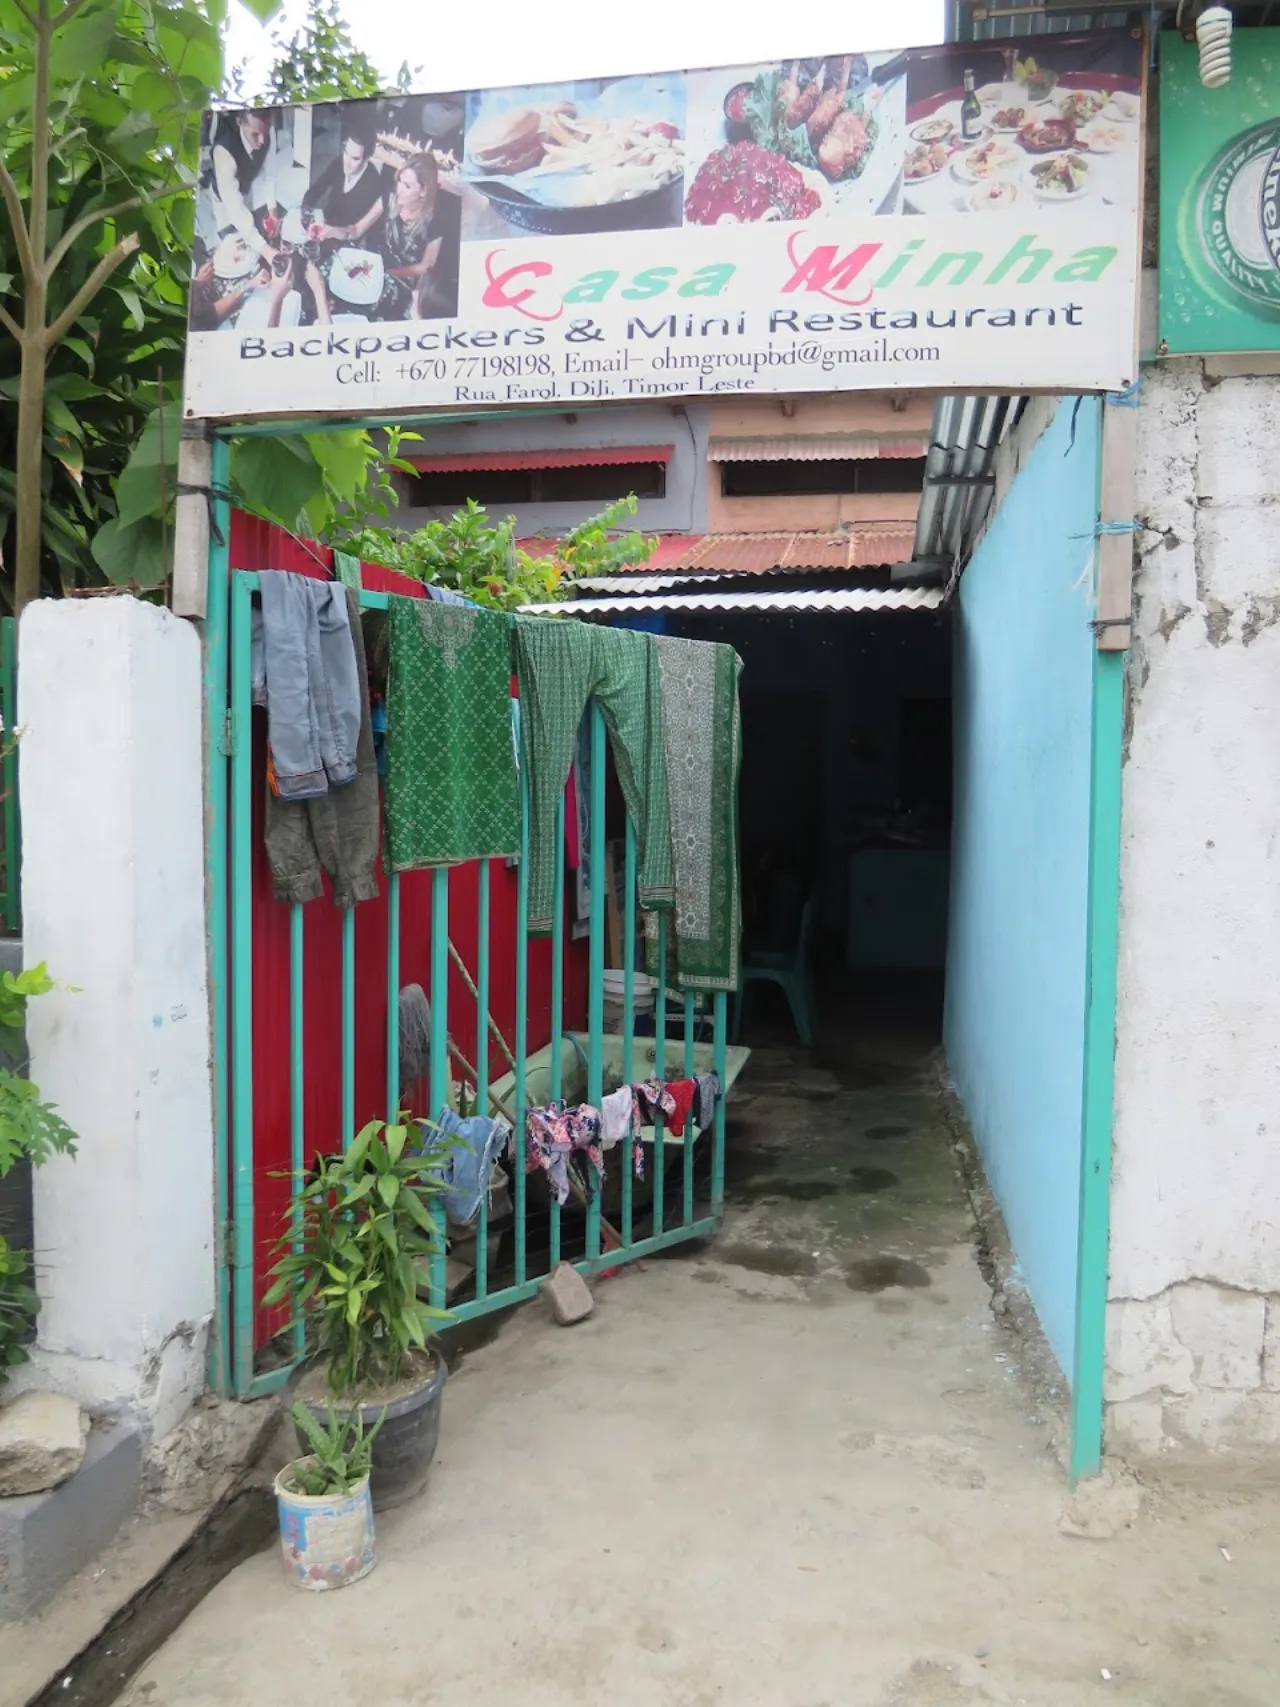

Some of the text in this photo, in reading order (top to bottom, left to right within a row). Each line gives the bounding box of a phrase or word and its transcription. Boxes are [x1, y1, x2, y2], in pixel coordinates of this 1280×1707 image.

[482, 230, 1118, 321] Casa Minha
[1212, 219, 1270, 293] QUALITY
[240, 302, 1083, 360] Backpackers & Mini Restaurant
[335, 360, 381, 385] Cell:
[395, 358, 447, 381] +670
[454, 354, 556, 379] 77198198,
[651, 338, 941, 374] ohmgroupbd@gmail.com
[455, 386, 496, 401] Rua
[622, 377, 689, 395] Timor
[699, 376, 755, 393] Leste
